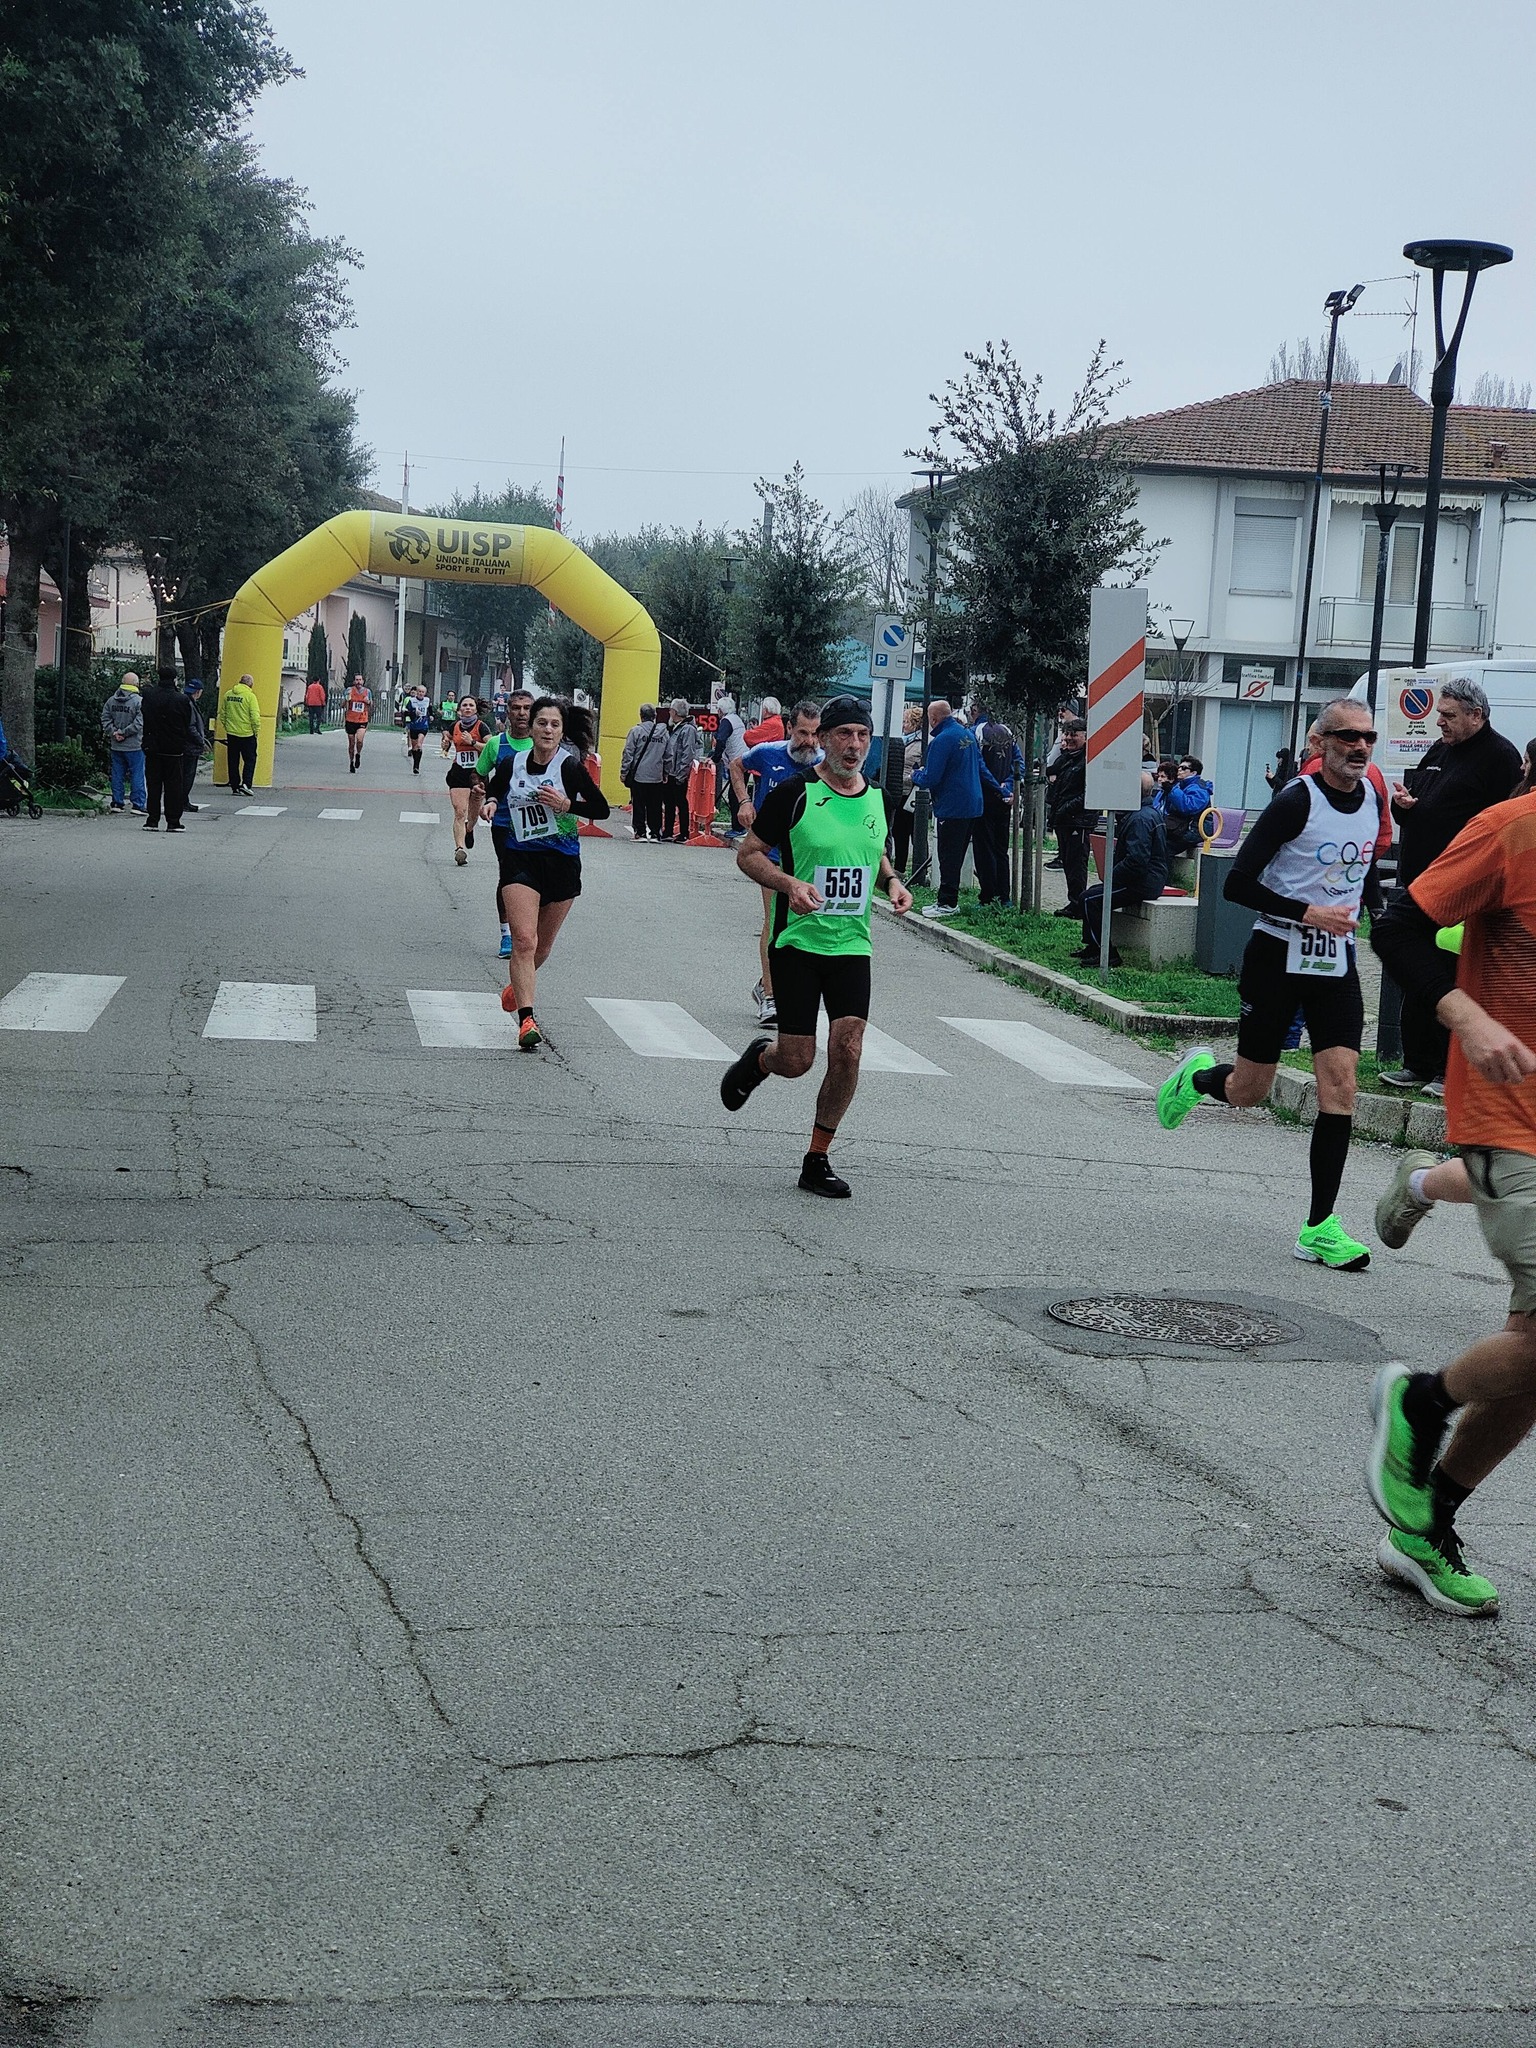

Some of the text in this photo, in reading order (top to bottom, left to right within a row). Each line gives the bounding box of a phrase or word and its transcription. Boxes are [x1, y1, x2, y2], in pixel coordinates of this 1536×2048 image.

[437, 528, 512, 558] UISP
[435, 554, 511, 568] UNIONE ITALIANA
[435, 563, 506, 576] SPORT PER TUTTI
[460, 751, 475, 763] 678
[518, 804, 549, 829] 709
[825, 868, 863, 899] 553
[1301, 925, 1337, 958] 556
